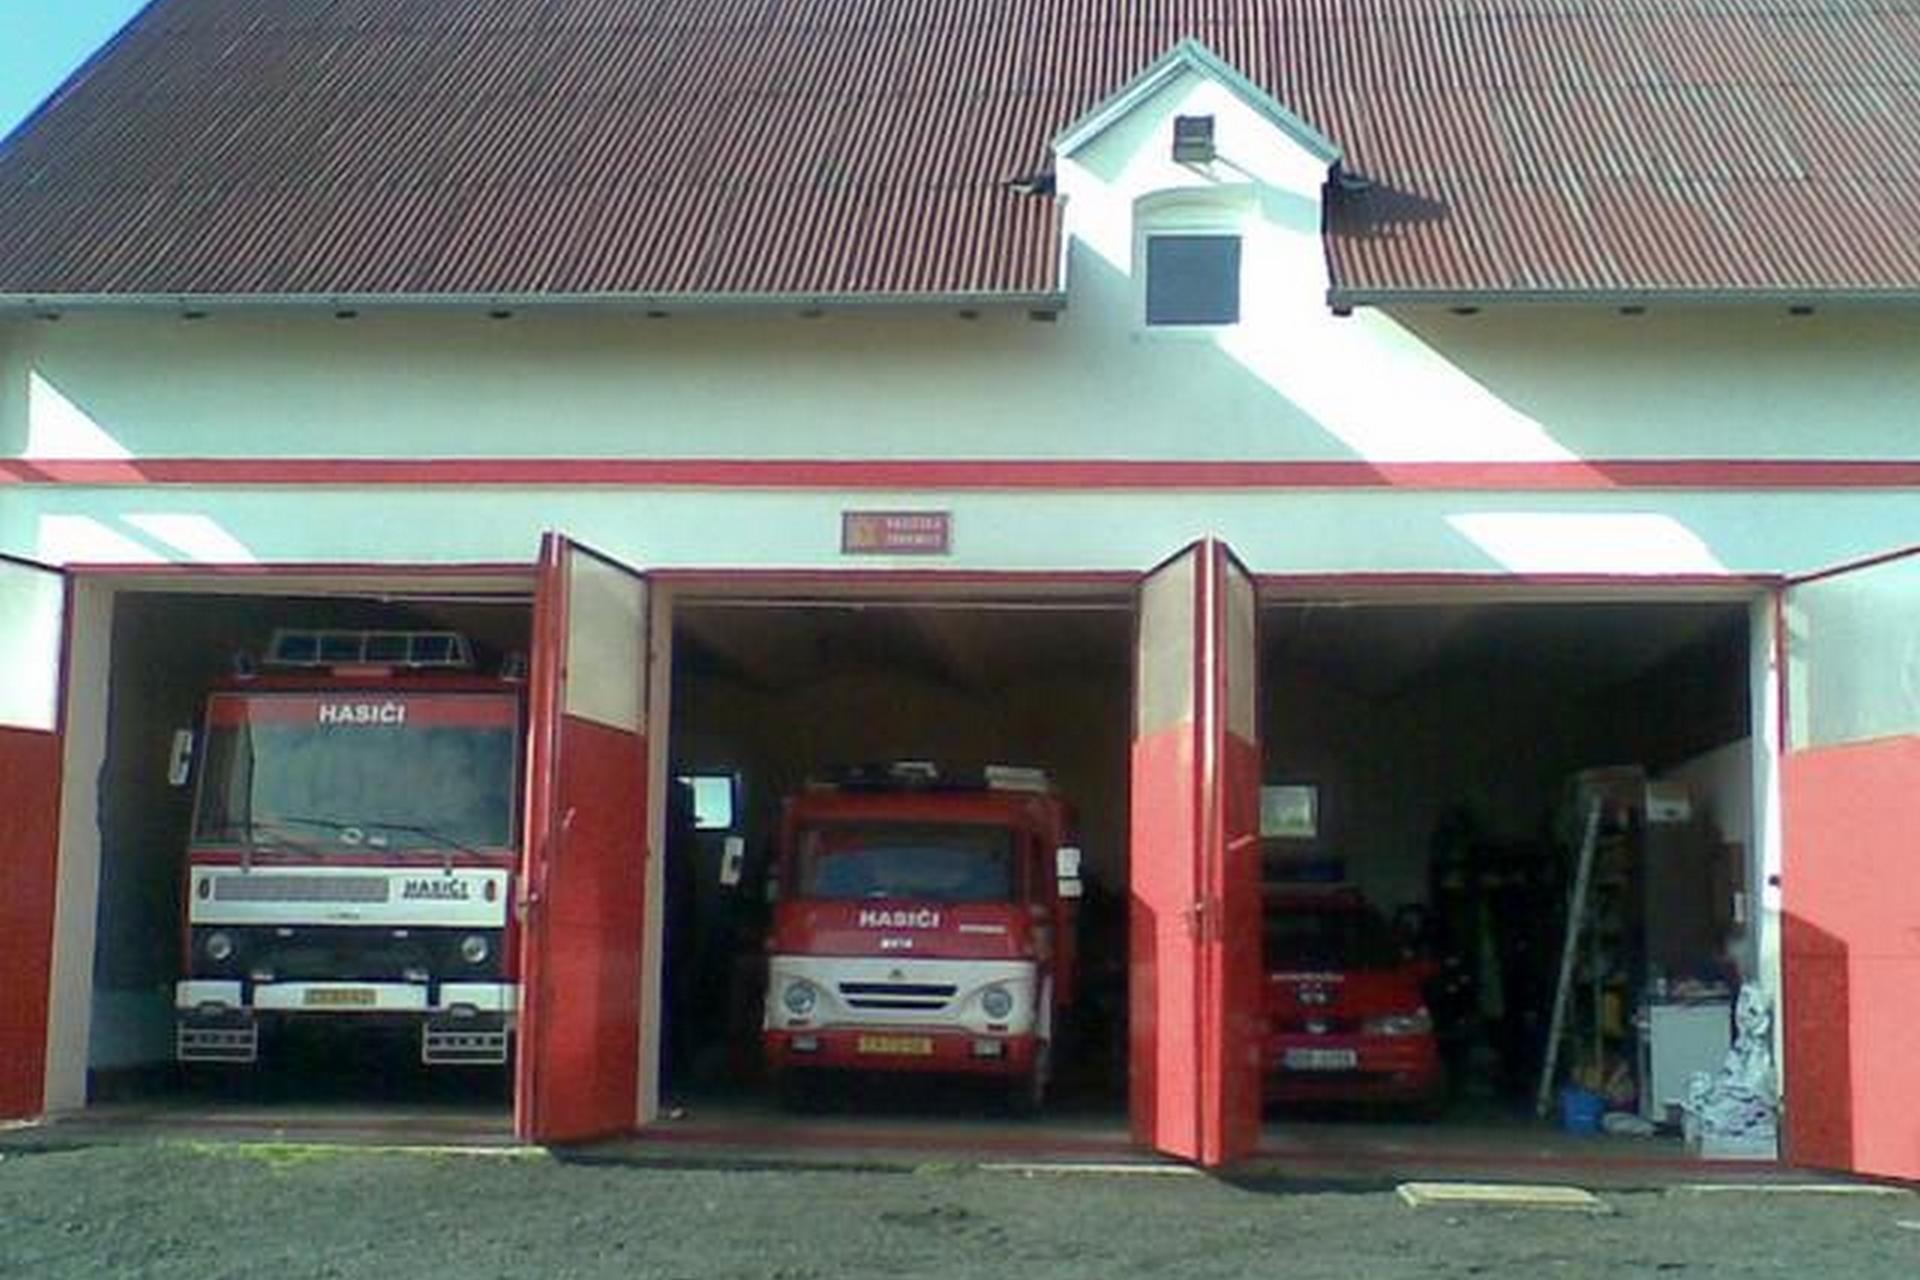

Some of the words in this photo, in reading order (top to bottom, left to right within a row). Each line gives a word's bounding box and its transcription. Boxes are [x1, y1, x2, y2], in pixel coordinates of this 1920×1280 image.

[319, 701, 405, 723] HASIČI
[404, 878, 468, 896] HASIČI
[859, 909, 940, 928] HASIČI
